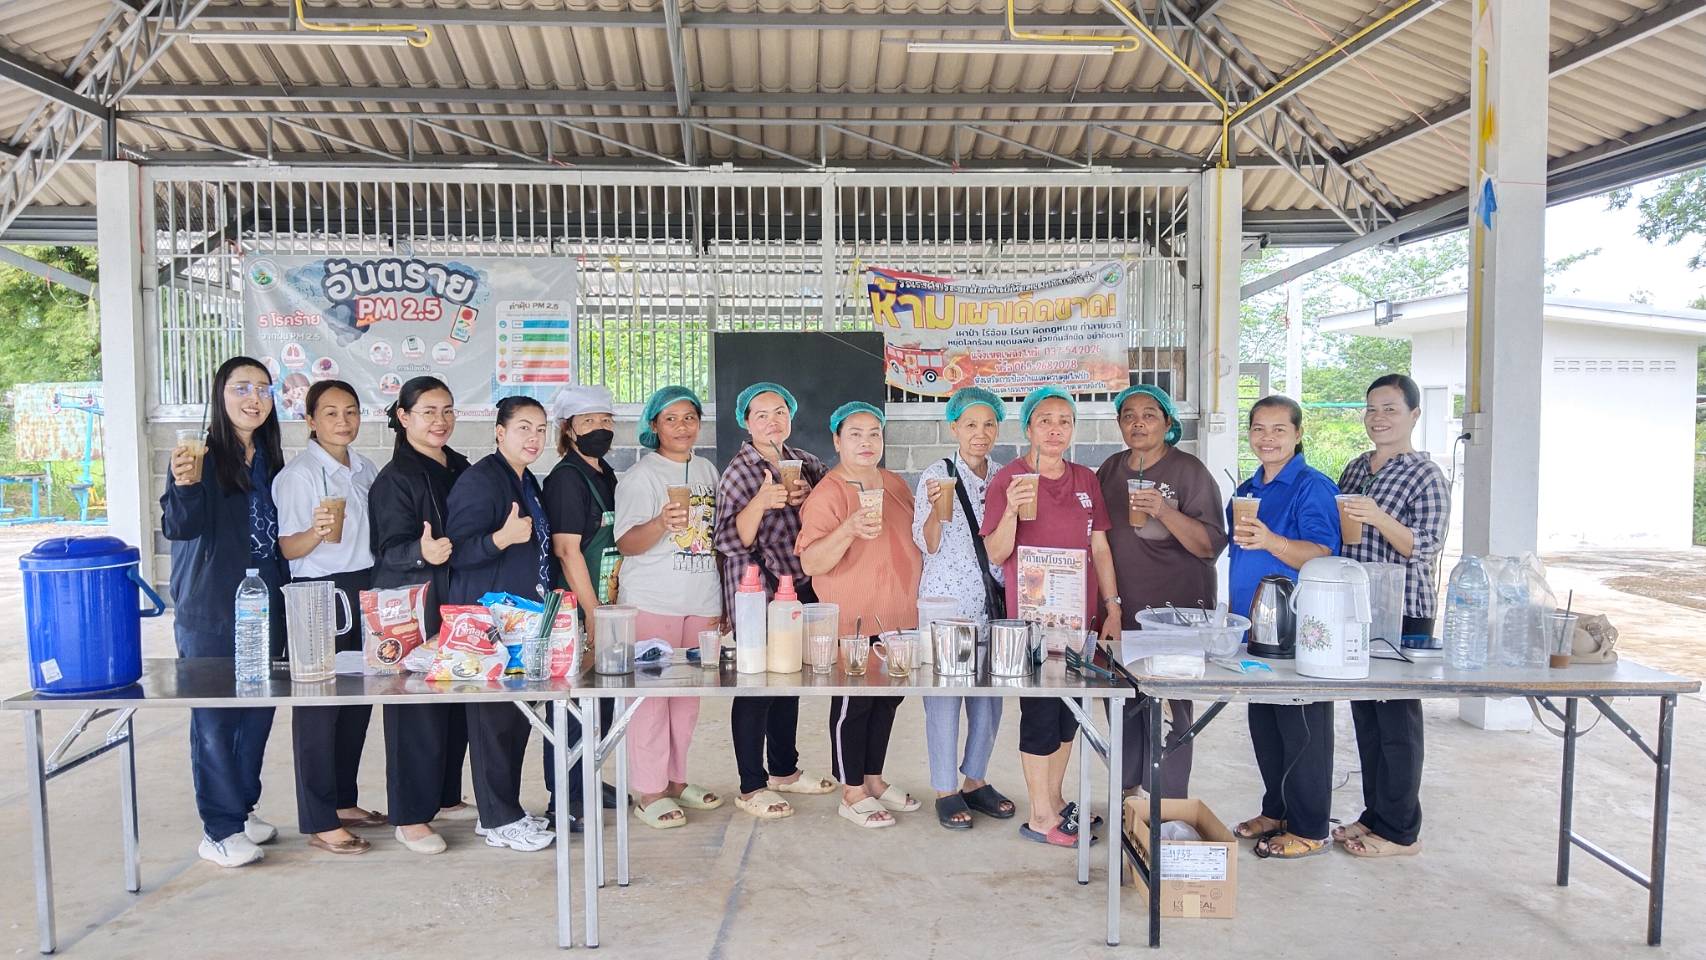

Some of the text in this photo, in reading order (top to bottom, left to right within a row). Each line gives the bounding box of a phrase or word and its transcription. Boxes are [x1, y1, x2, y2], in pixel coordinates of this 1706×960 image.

[325, 259, 475, 301] อันตราย
[357, 297, 442, 321] PM 2.5
[869, 276, 956, 330] ห้าม
[270, 311, 320, 327] โรคร้าย
[290, 332, 304, 341] PM
[955, 328, 979, 337] เผาป่า
[1010, 326, 1029, 336] ไร่นา
[1032, 324, 1077, 335] ผิดกฎหมาย
[947, 337, 993, 347] หยุดโลกร้อน
